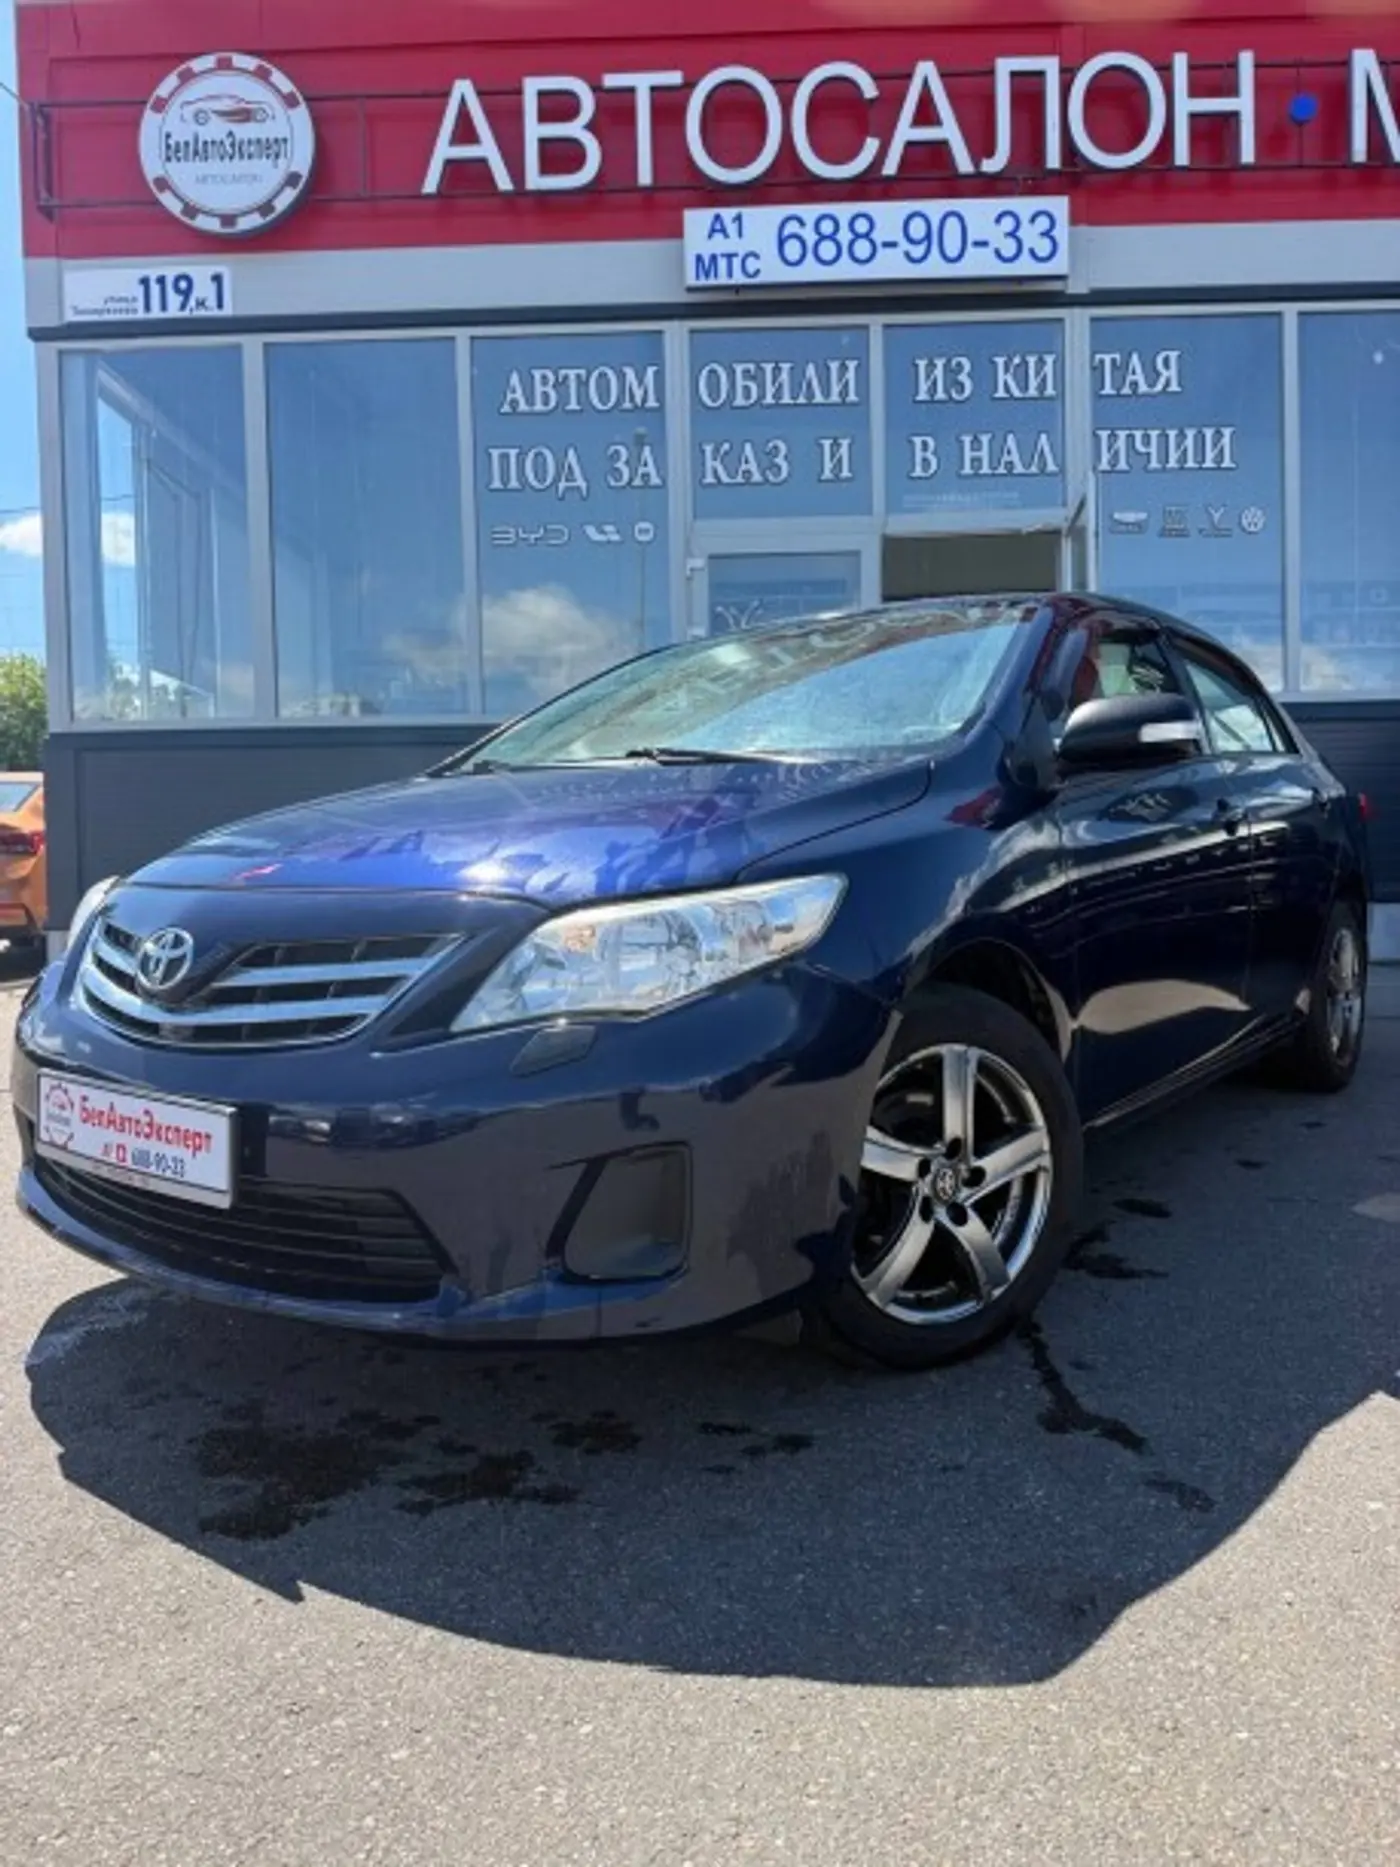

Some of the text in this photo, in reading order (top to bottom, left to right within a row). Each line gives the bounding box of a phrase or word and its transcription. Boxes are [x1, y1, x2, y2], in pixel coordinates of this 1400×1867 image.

[164, 130, 289, 169] БелАвтоЭксперт
[421, 51, 1254, 195] АВТОСАЛОН
[777, 210, 1058, 267] 688-90-33
[914, 356, 974, 401] ИЗ
[487, 446, 588, 499] ПОД
[819, 438, 853, 481] И
[909, 435, 938, 477] В
[79, 1094, 213, 1158] БелАвтоЭксперт
